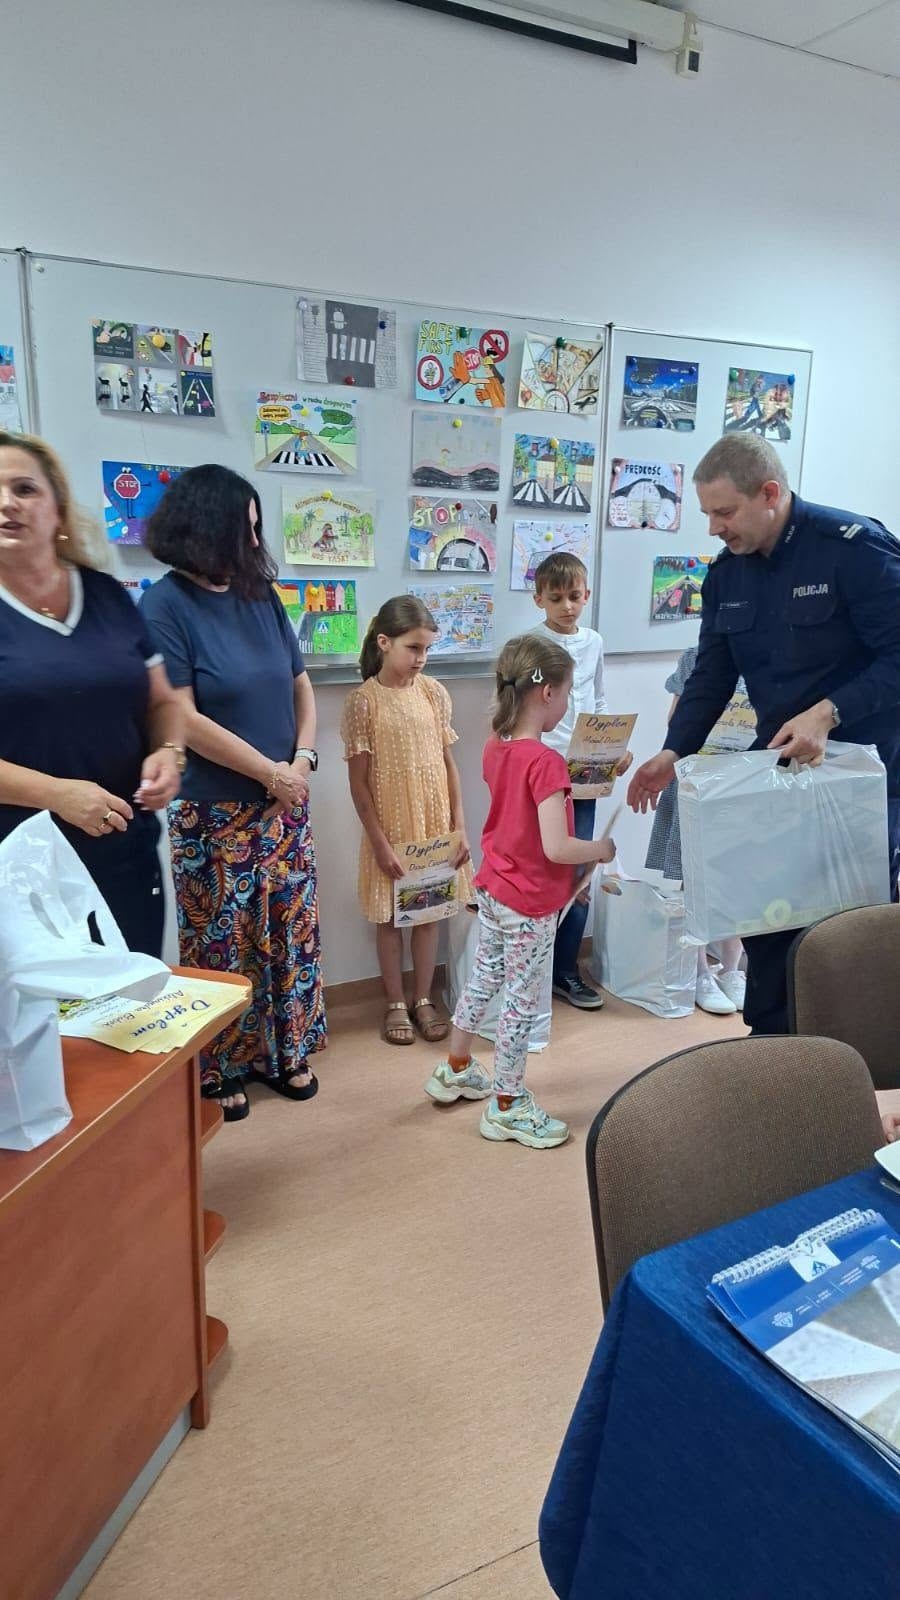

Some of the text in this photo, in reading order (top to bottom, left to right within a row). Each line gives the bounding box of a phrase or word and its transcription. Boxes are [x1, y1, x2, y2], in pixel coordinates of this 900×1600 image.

[421, 320, 473, 345] SAFETY
[418, 336, 454, 355] FIRST
[464, 352, 481, 369] STOP
[118, 480, 138, 489] STOP
[413, 504, 458, 527] STOP
[793, 583, 829, 599] POLICJA
[405, 840, 450, 858] Dyplom
[131, 999, 212, 1038] Dyplom
